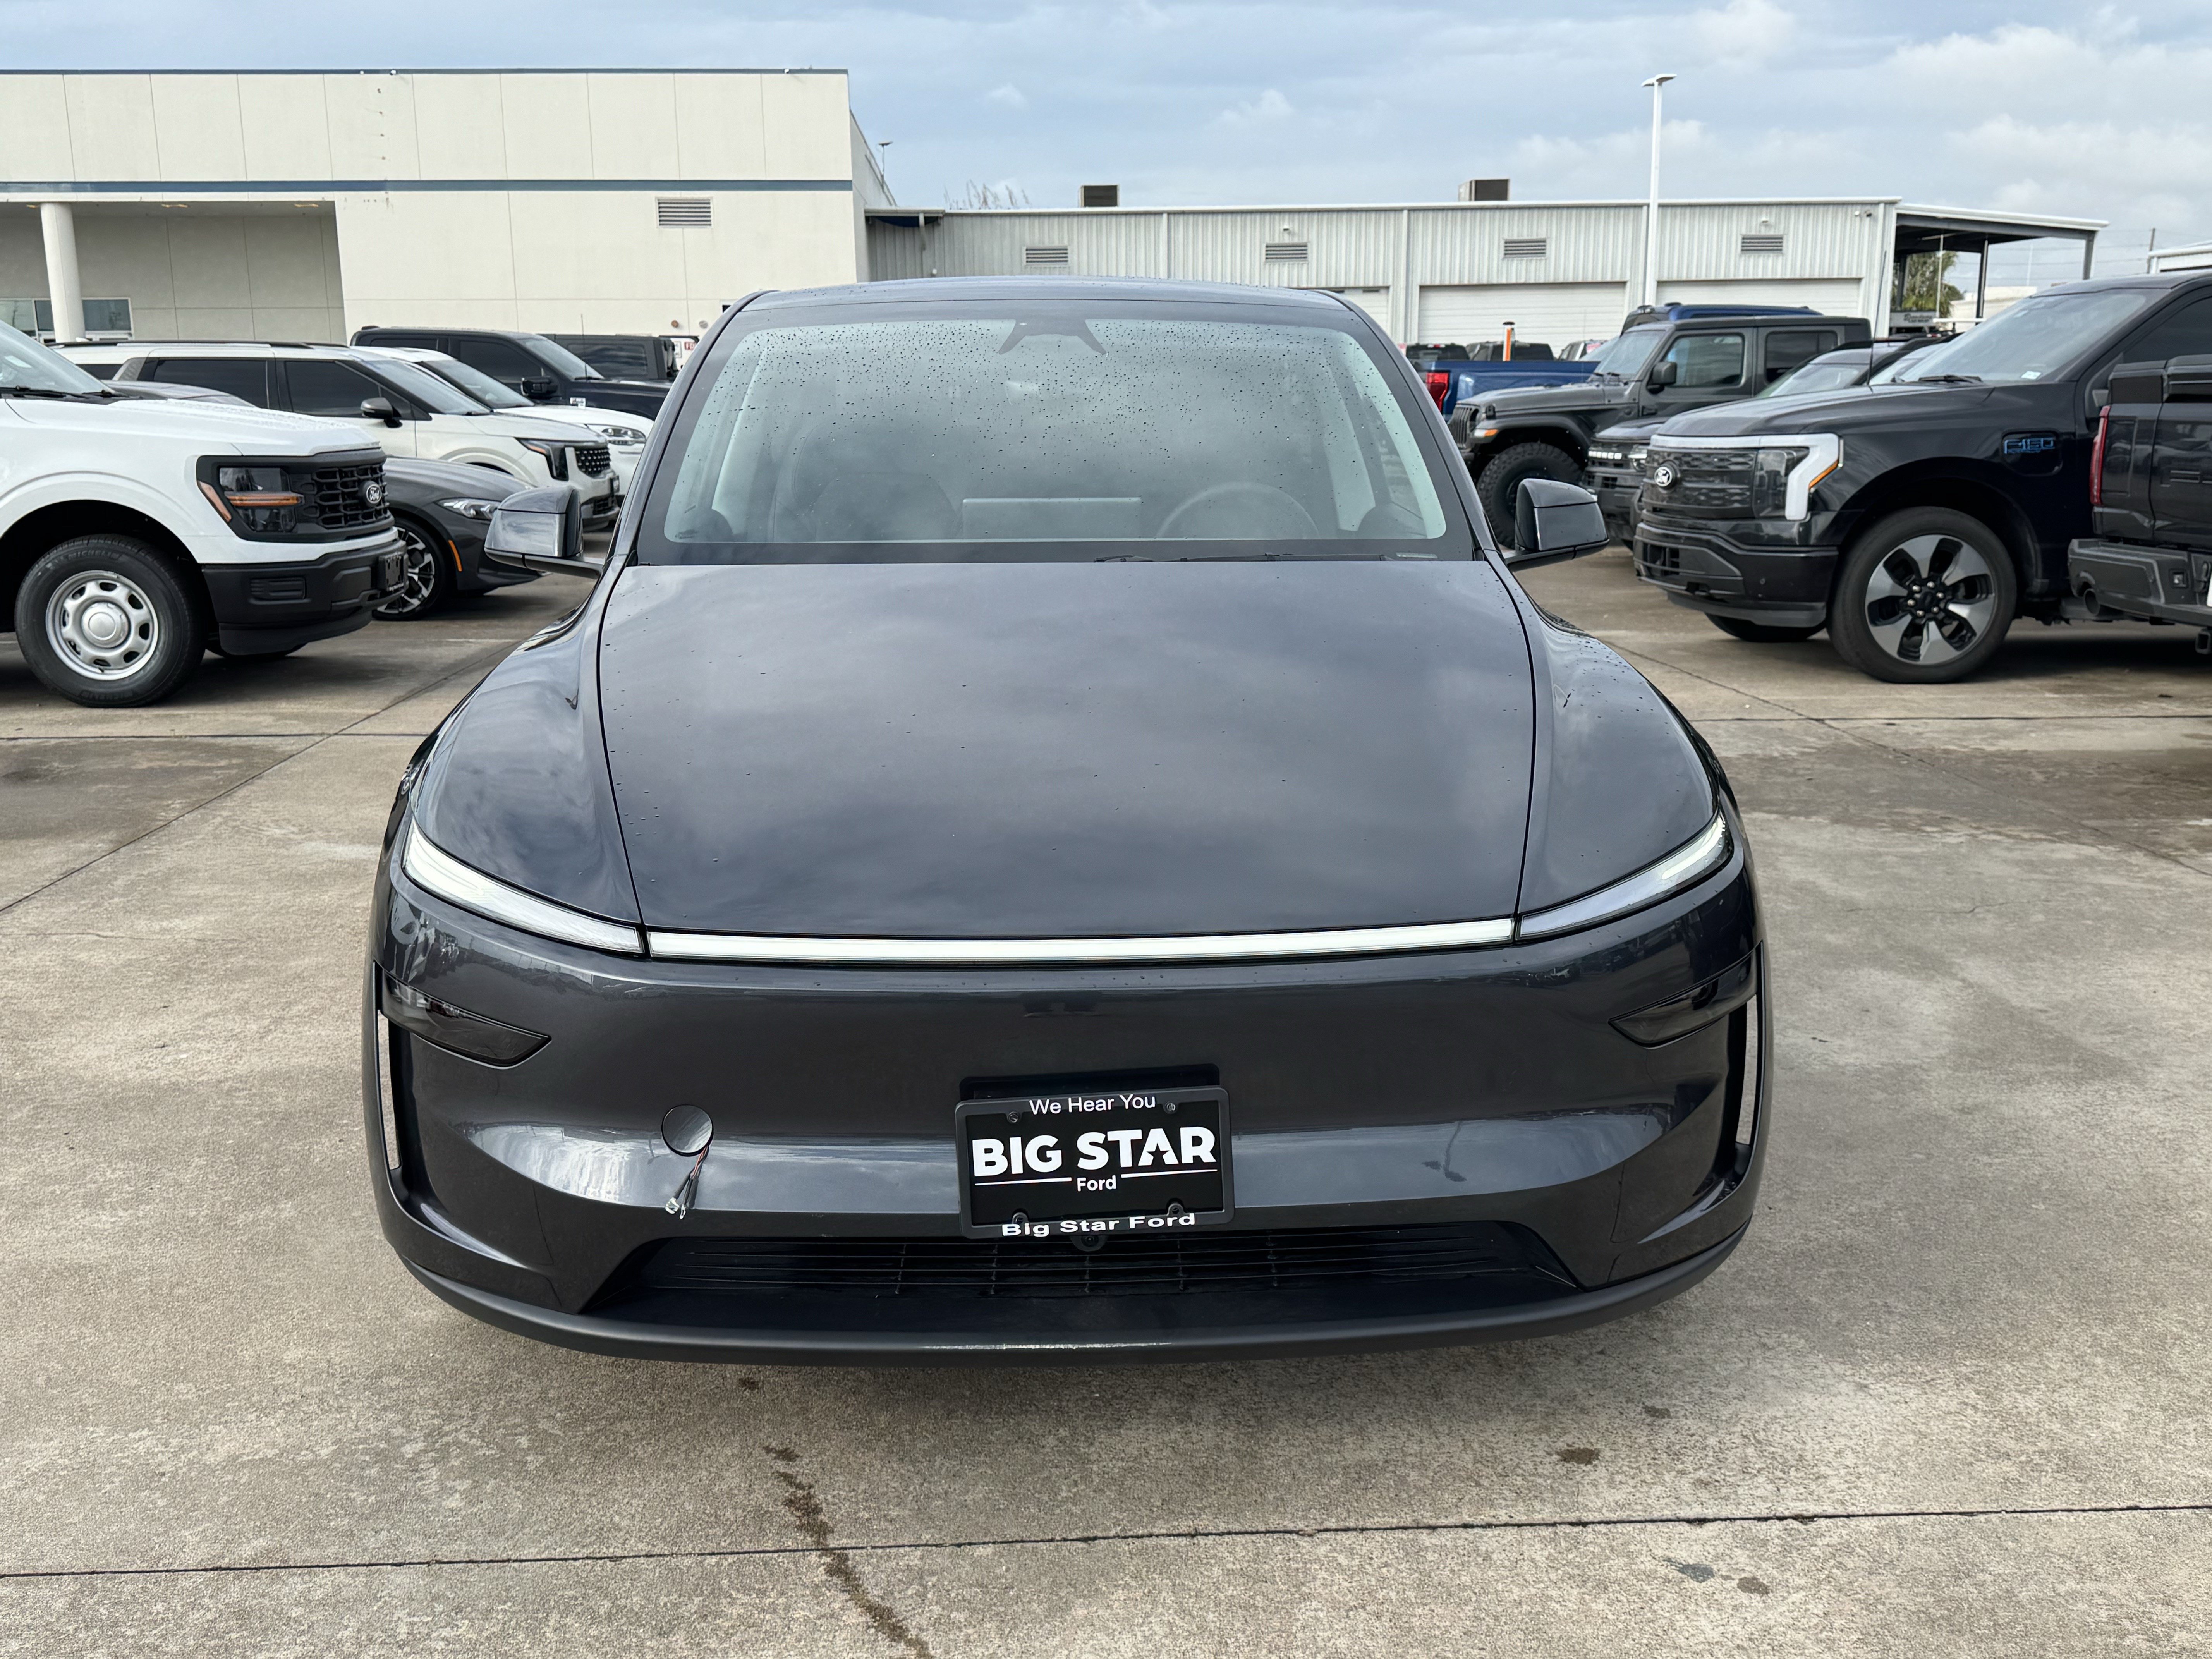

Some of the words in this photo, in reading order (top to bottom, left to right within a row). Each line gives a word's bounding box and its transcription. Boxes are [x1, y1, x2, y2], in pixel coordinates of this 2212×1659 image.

[1029, 1099, 1062, 1115] We
[1068, 1096, 1115, 1113] Hear
[1119, 1093, 1156, 1109] You
[972, 1134, 1062, 1177] BIG
[1076, 1126, 1217, 1170] STAR
[1077, 1175, 1117, 1192] Ford
[1001, 1222, 1050, 1237] Big
[1060, 1220, 1120, 1233] Star
[1129, 1212, 1195, 1229] Ford
